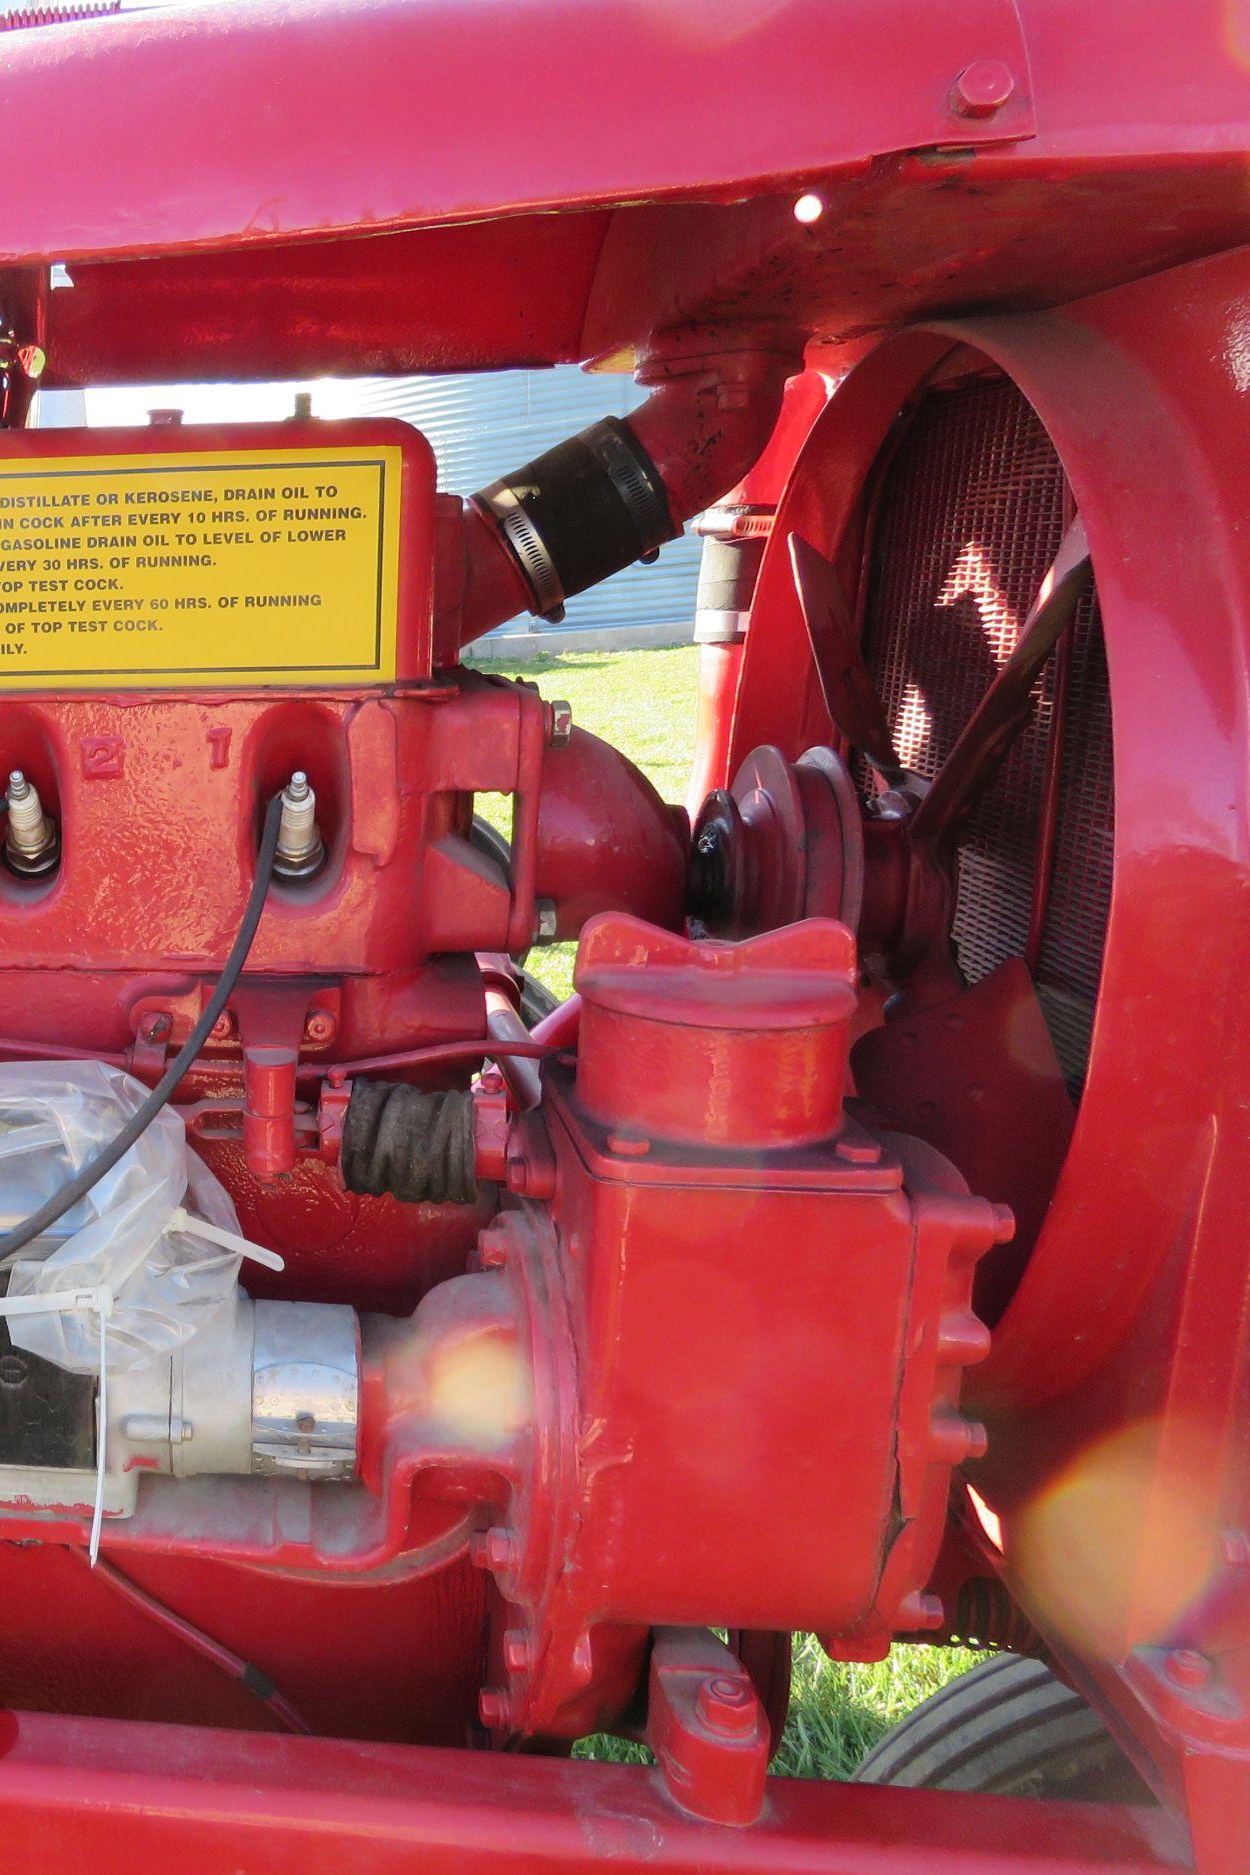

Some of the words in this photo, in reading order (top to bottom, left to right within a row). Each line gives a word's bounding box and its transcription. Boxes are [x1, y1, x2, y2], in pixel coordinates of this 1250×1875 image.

[0, 494, 90, 509] DISTILLATE
[96, 494, 118, 505] OR
[125, 490, 218, 504] KEROSENE,
[224, 488, 275, 501] DRAIN
[282, 487, 309, 499] OIL
[315, 486, 337, 498] TO
[20, 517, 64, 529] COCK
[70, 515, 122, 527] AFTER
[128, 512, 181, 525] EVERY
[188, 512, 206, 524] 10
[212, 511, 249, 523] HRS.
[256, 510, 277, 522] OF
[283, 507, 366, 521] RUNNING.
[1, 537, 81, 551] GASOLINE
[87, 536, 136, 548] DRAIN
[143, 535, 169, 547] OIL
[175, 533, 197, 545] TO
[203, 532, 254, 545] LEVEL
[260, 531, 281, 543] OF
[288, 529, 346, 542] LOWER
[43, 559, 61, 571] 30
[67, 558, 103, 570] HRS.
[109, 557, 130, 569] OF
[136, 555, 216, 568] RUNNING.
[28, 580, 68, 592] TEST
[74, 579, 123, 591] COCK.
[92, 599, 144, 611] EVERY
[149, 598, 168, 610] 60
[175, 597, 211, 609] HRS.
[218, 597, 239, 608] OF
[245, 595, 321, 608] RUNNING
[5, 623, 25, 634] OF
[31, 622, 62, 633] TOP
[68, 621, 108, 632] TEST
[113, 620, 163, 631] COCK.
[81, 736, 125, 779] 2
